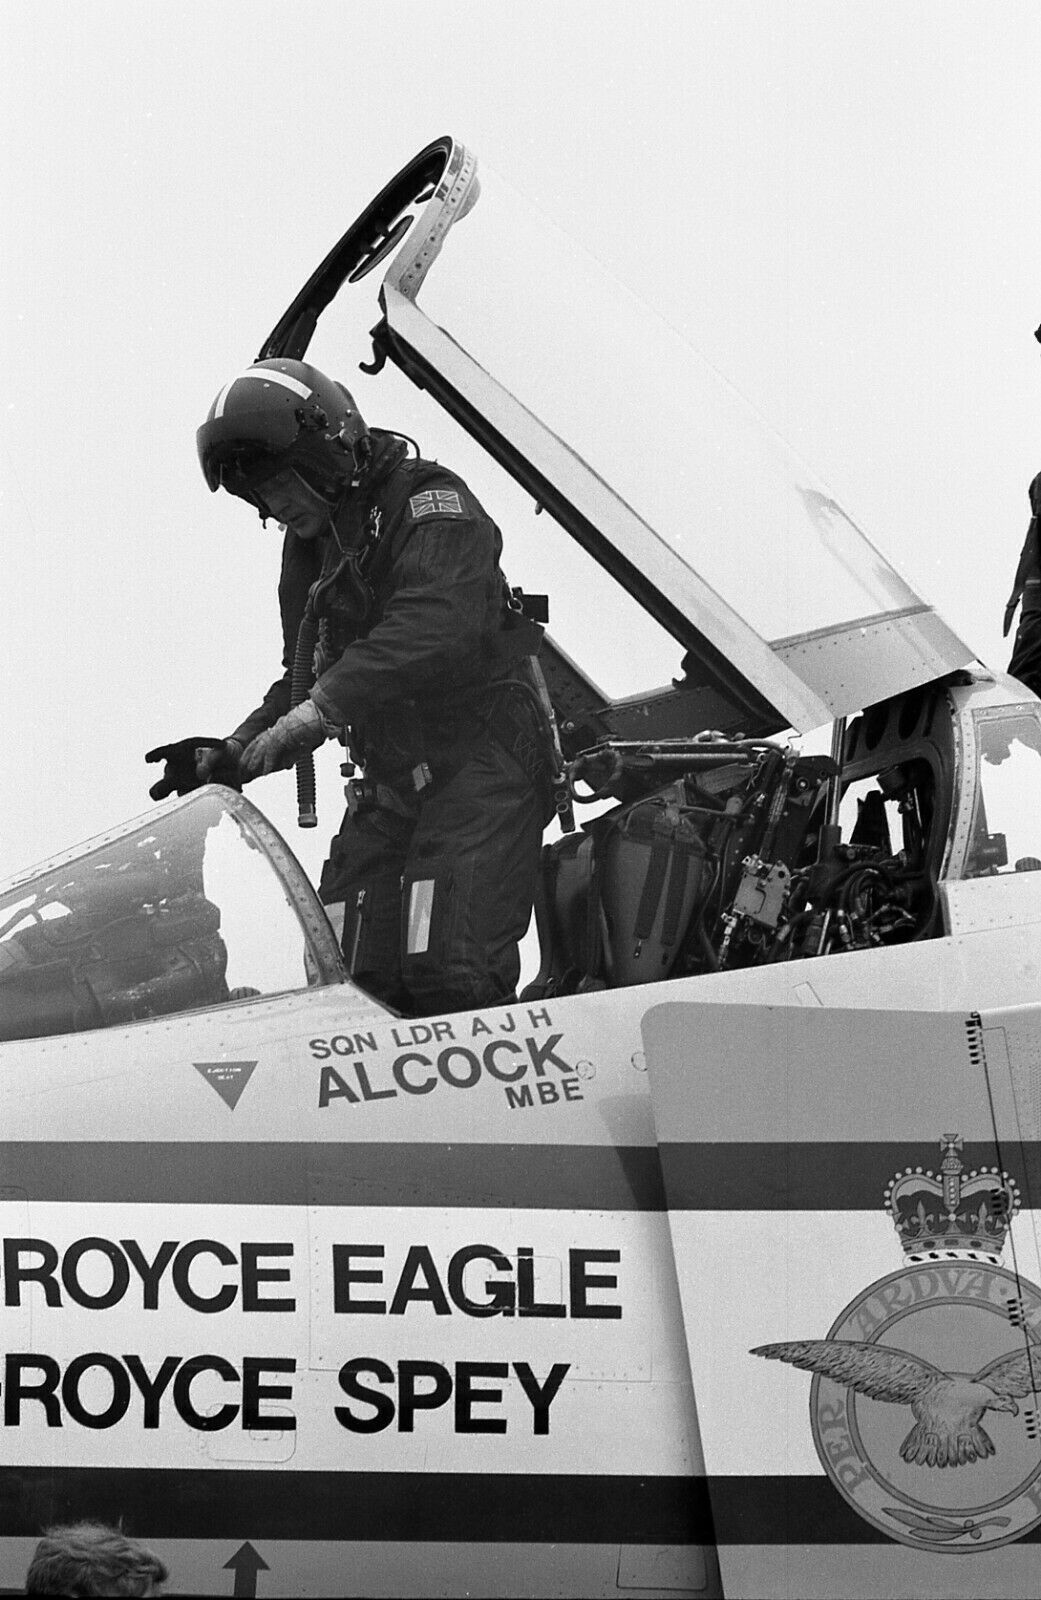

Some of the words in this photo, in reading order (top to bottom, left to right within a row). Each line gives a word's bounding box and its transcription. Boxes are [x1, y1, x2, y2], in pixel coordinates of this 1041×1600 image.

[308, 1032, 378, 1060] SQN
[391, 1020, 456, 1048] LDR
[471, 1016, 493, 1037] A
[500, 1012, 516, 1033] J
[528, 1007, 553, 1028] H
[317, 1032, 576, 1109] ALCOCK
[504, 1077, 585, 1110] MBE
[2, 1237, 297, 1314] ROYCE
[332, 1243, 623, 1320] EAGLE
[3, 1352, 298, 1432] ROYCE
[334, 1356, 573, 1435] SPEY
[819, 1399, 872, 1494] PER
